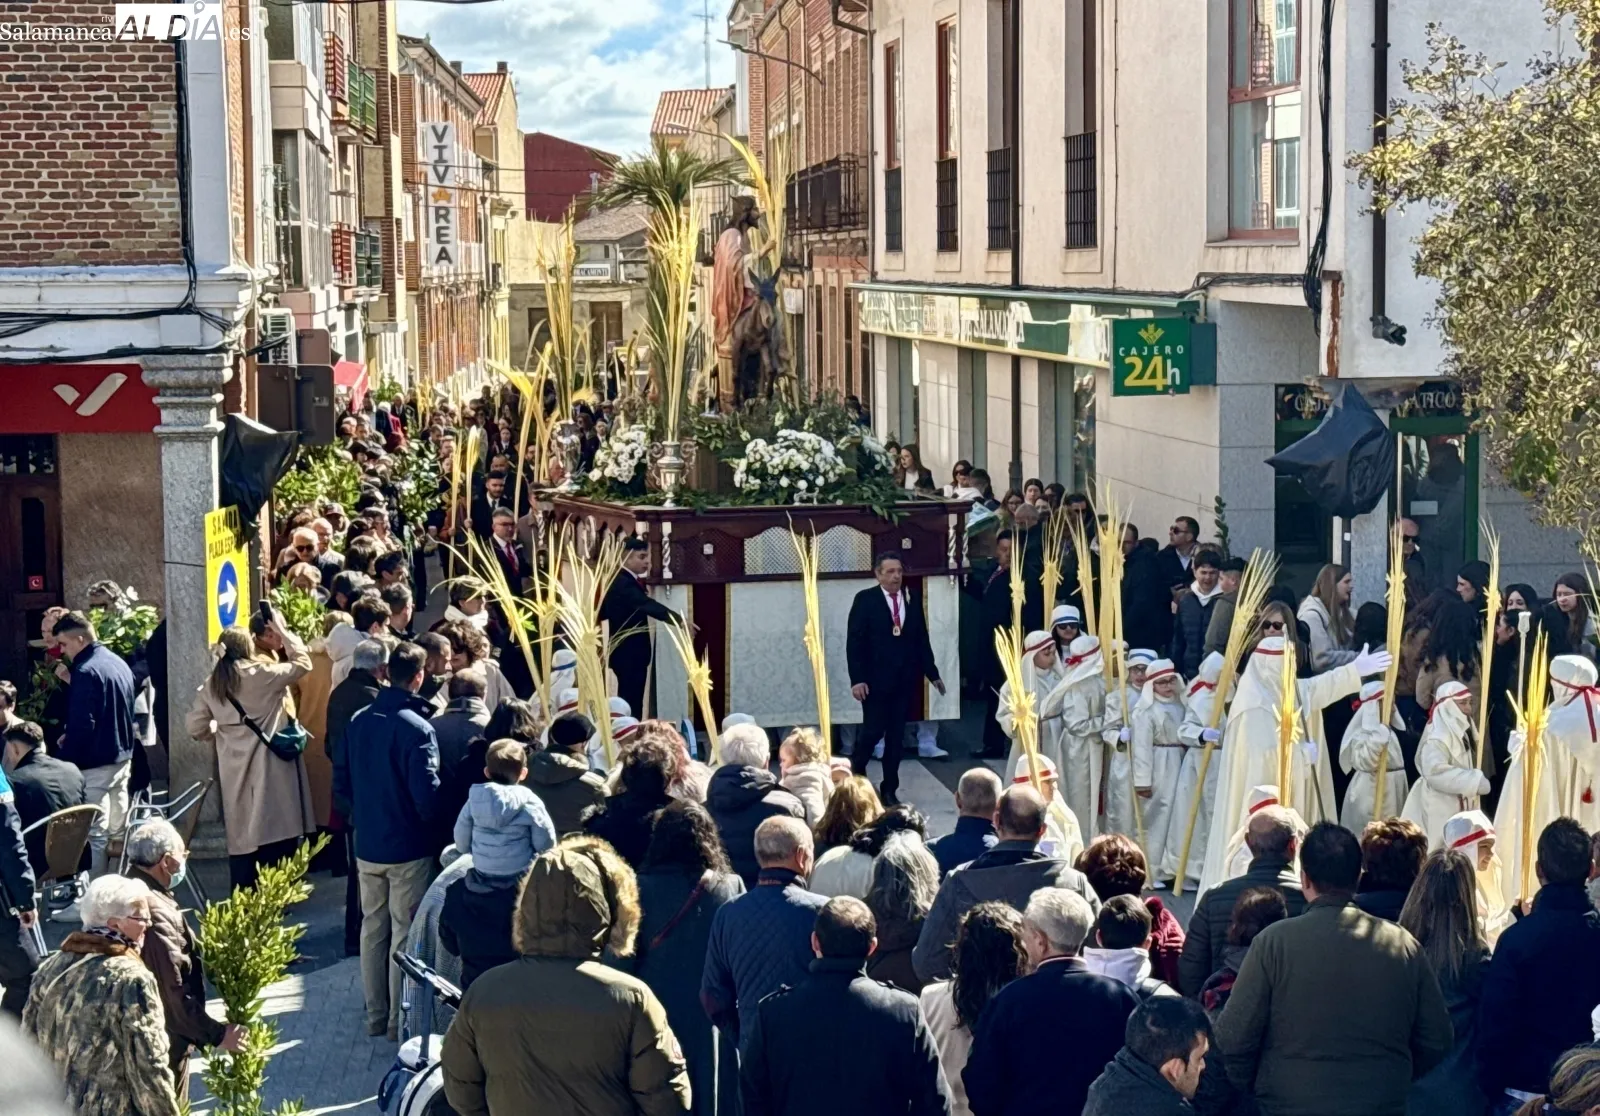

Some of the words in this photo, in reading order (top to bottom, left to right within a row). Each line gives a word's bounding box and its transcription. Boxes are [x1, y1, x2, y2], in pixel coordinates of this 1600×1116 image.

[1118, 345, 1185, 357] CAJERO
[1123, 355, 1181, 392] 24h
[212, 509, 239, 537] SALIDA
[208, 539, 225, 561] PLAZA
